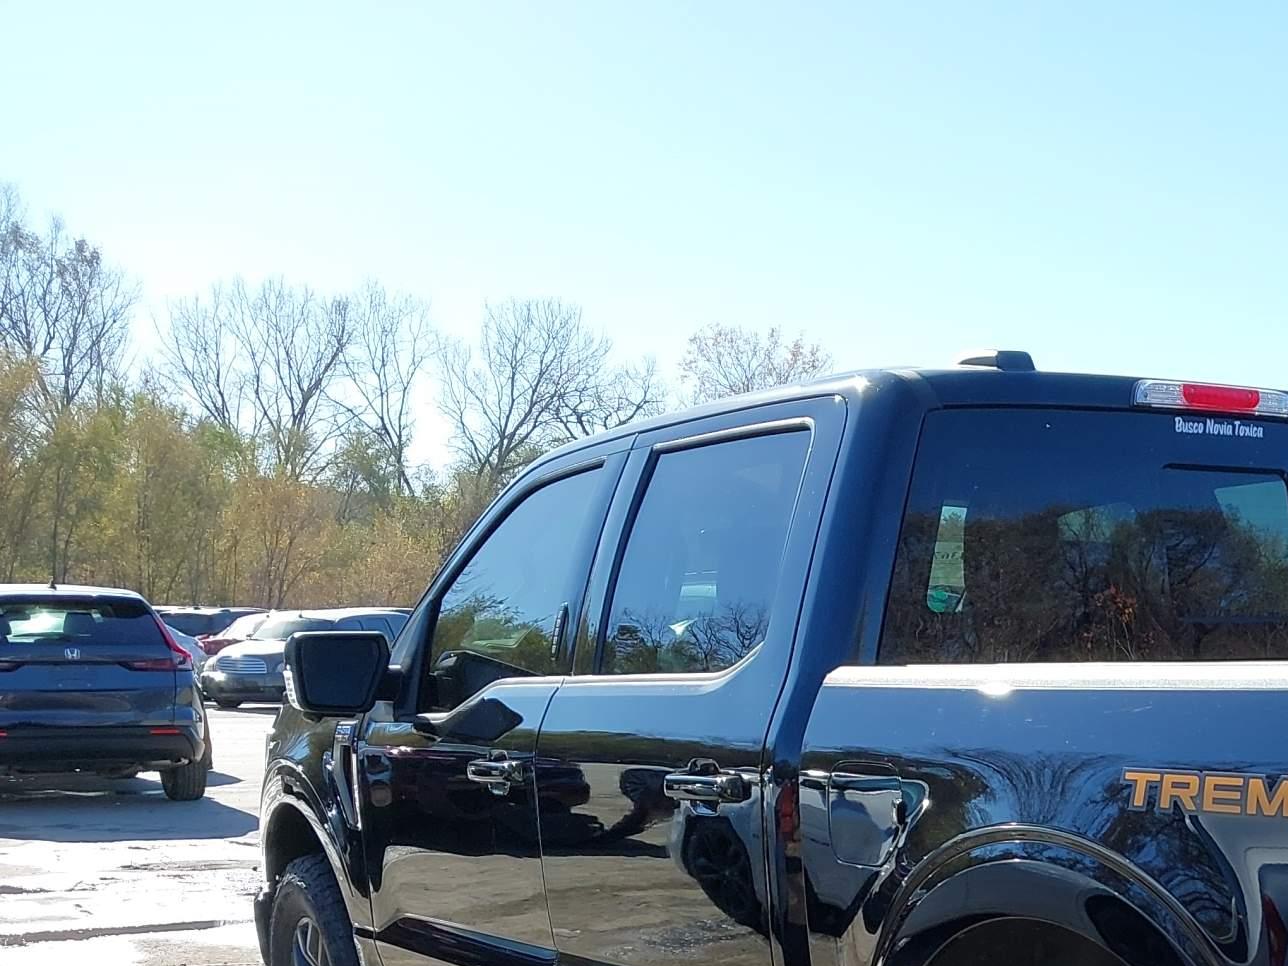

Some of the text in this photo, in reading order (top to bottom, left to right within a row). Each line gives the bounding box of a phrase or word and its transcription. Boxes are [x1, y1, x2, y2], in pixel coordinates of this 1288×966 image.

[1174, 416, 1264, 438] Busco Novia Toxica
